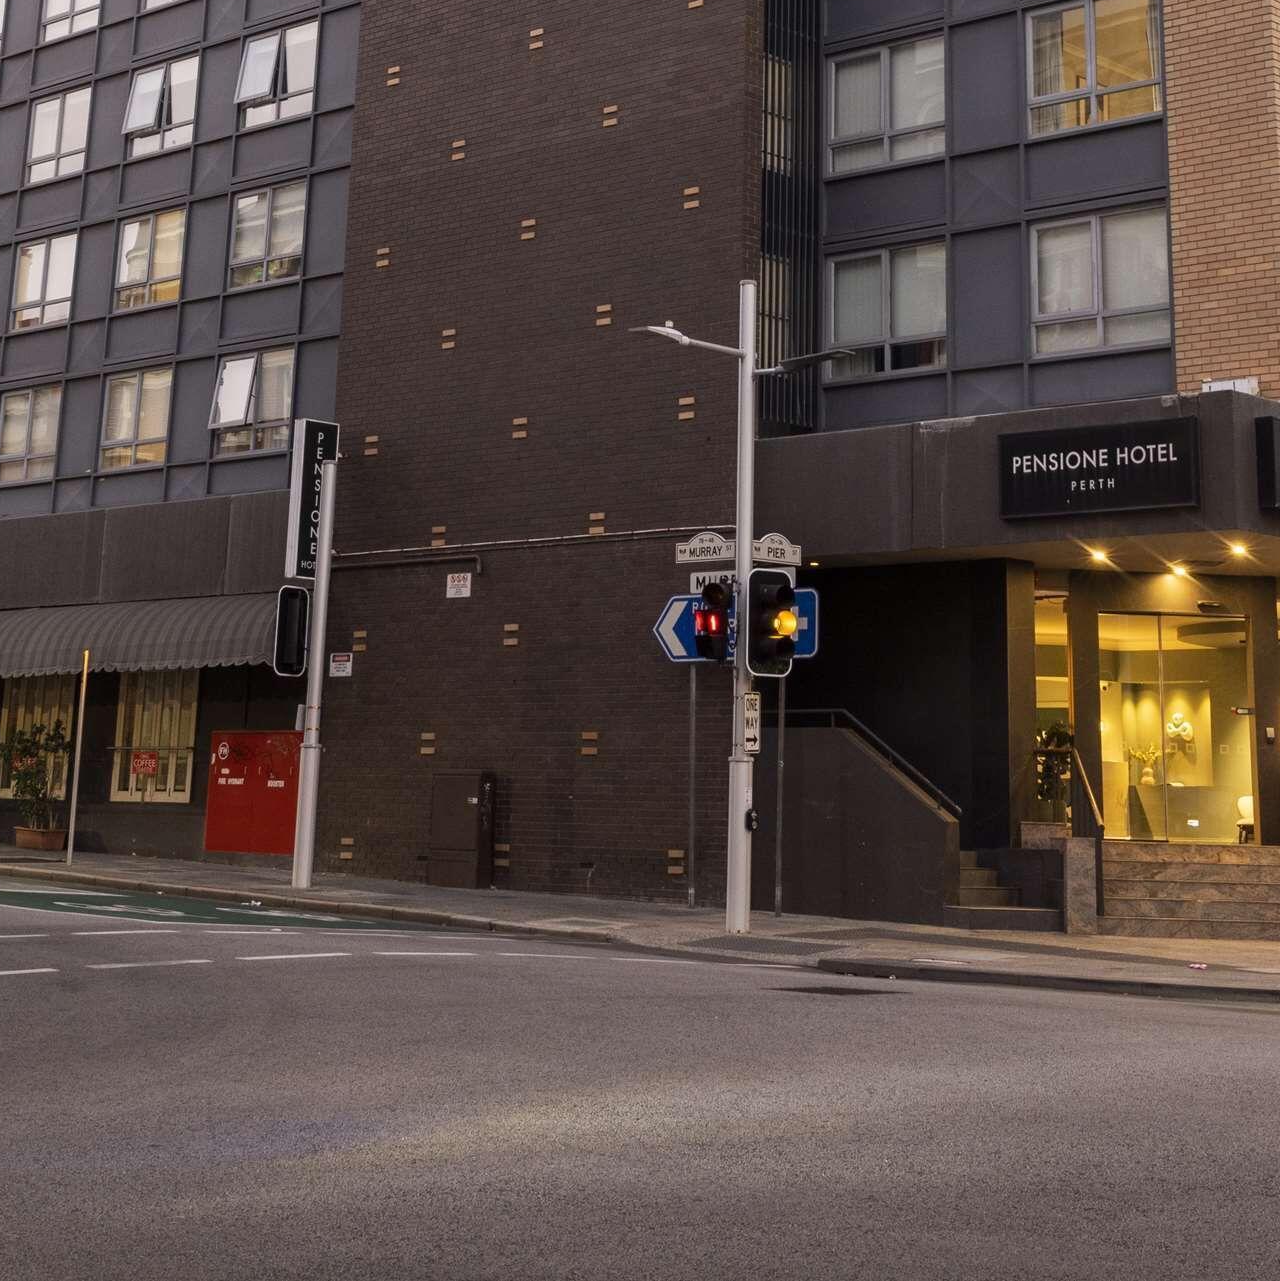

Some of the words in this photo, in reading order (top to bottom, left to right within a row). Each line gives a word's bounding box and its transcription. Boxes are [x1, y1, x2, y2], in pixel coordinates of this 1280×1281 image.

[1012, 449, 1109, 475] PENSIONE
[1116, 443, 1178, 466] HOTEL
[1071, 478, 1116, 491] PERTH
[309, 431, 325, 556] PENSIONE
[689, 545, 722, 558] MURRAY
[767, 546, 786, 559] PIER
[745, 698, 758, 712] ONE
[745, 717, 759, 730] WAY
[133, 759, 156, 769] COFFEE
